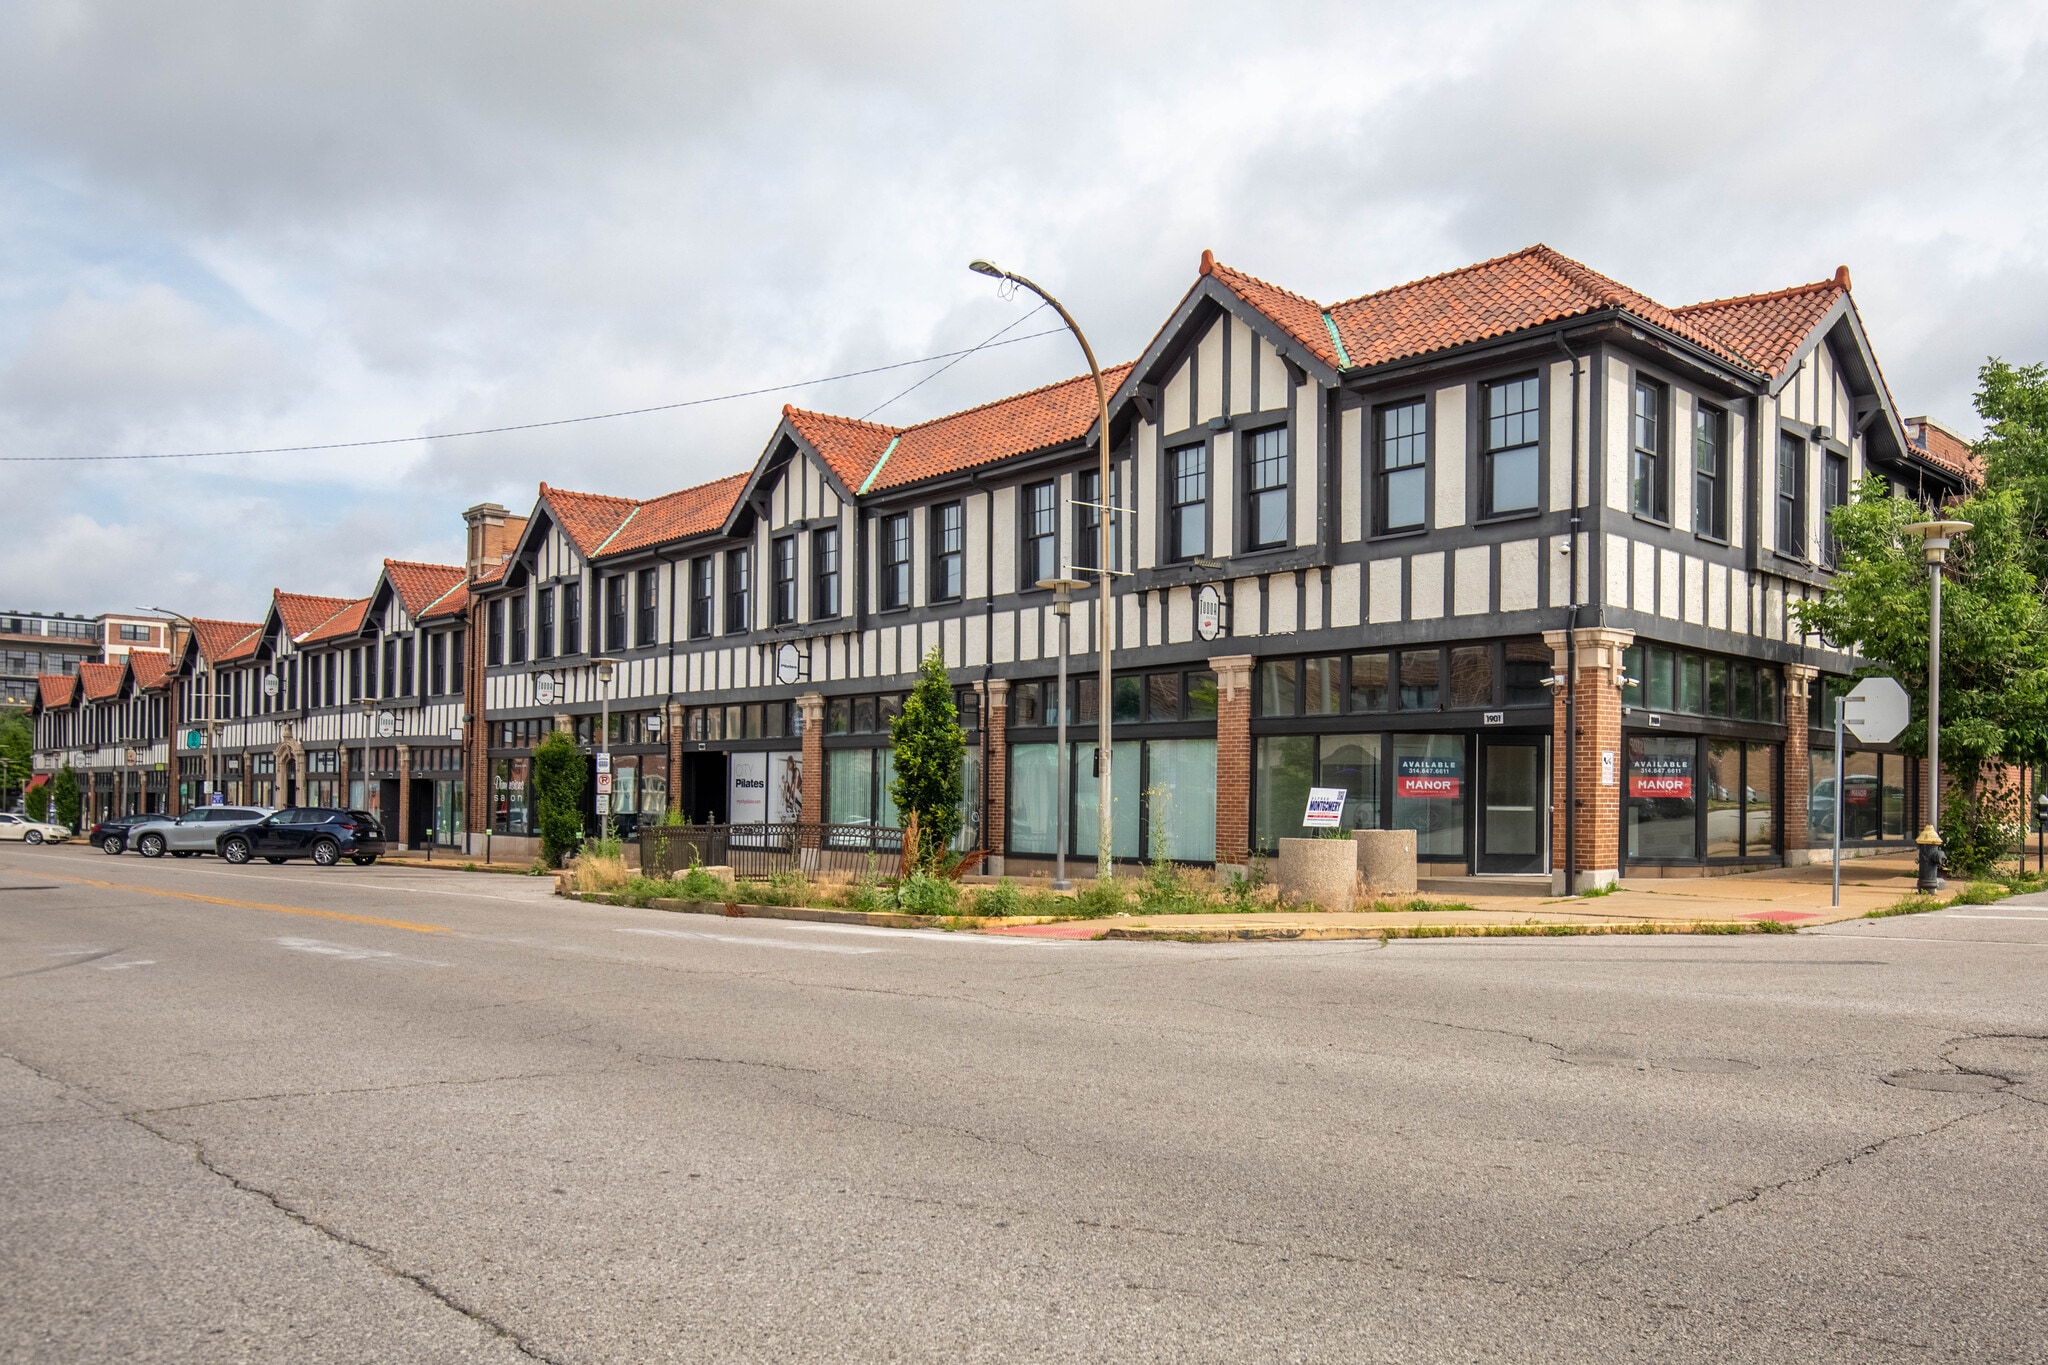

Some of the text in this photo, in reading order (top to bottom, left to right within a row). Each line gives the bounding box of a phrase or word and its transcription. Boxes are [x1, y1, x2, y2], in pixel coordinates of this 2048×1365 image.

[1199, 599, 1218, 616] TUDOR
[1486, 714, 1502, 723] 1901
[736, 763, 753, 777] CITY
[735, 779, 764, 788] Pilates
[1406, 780, 1451, 790] MANOR
[1638, 780, 1683, 790] MANOR
[493, 794, 523, 802] saon
[1309, 800, 1342, 812] MONTGOMERY
